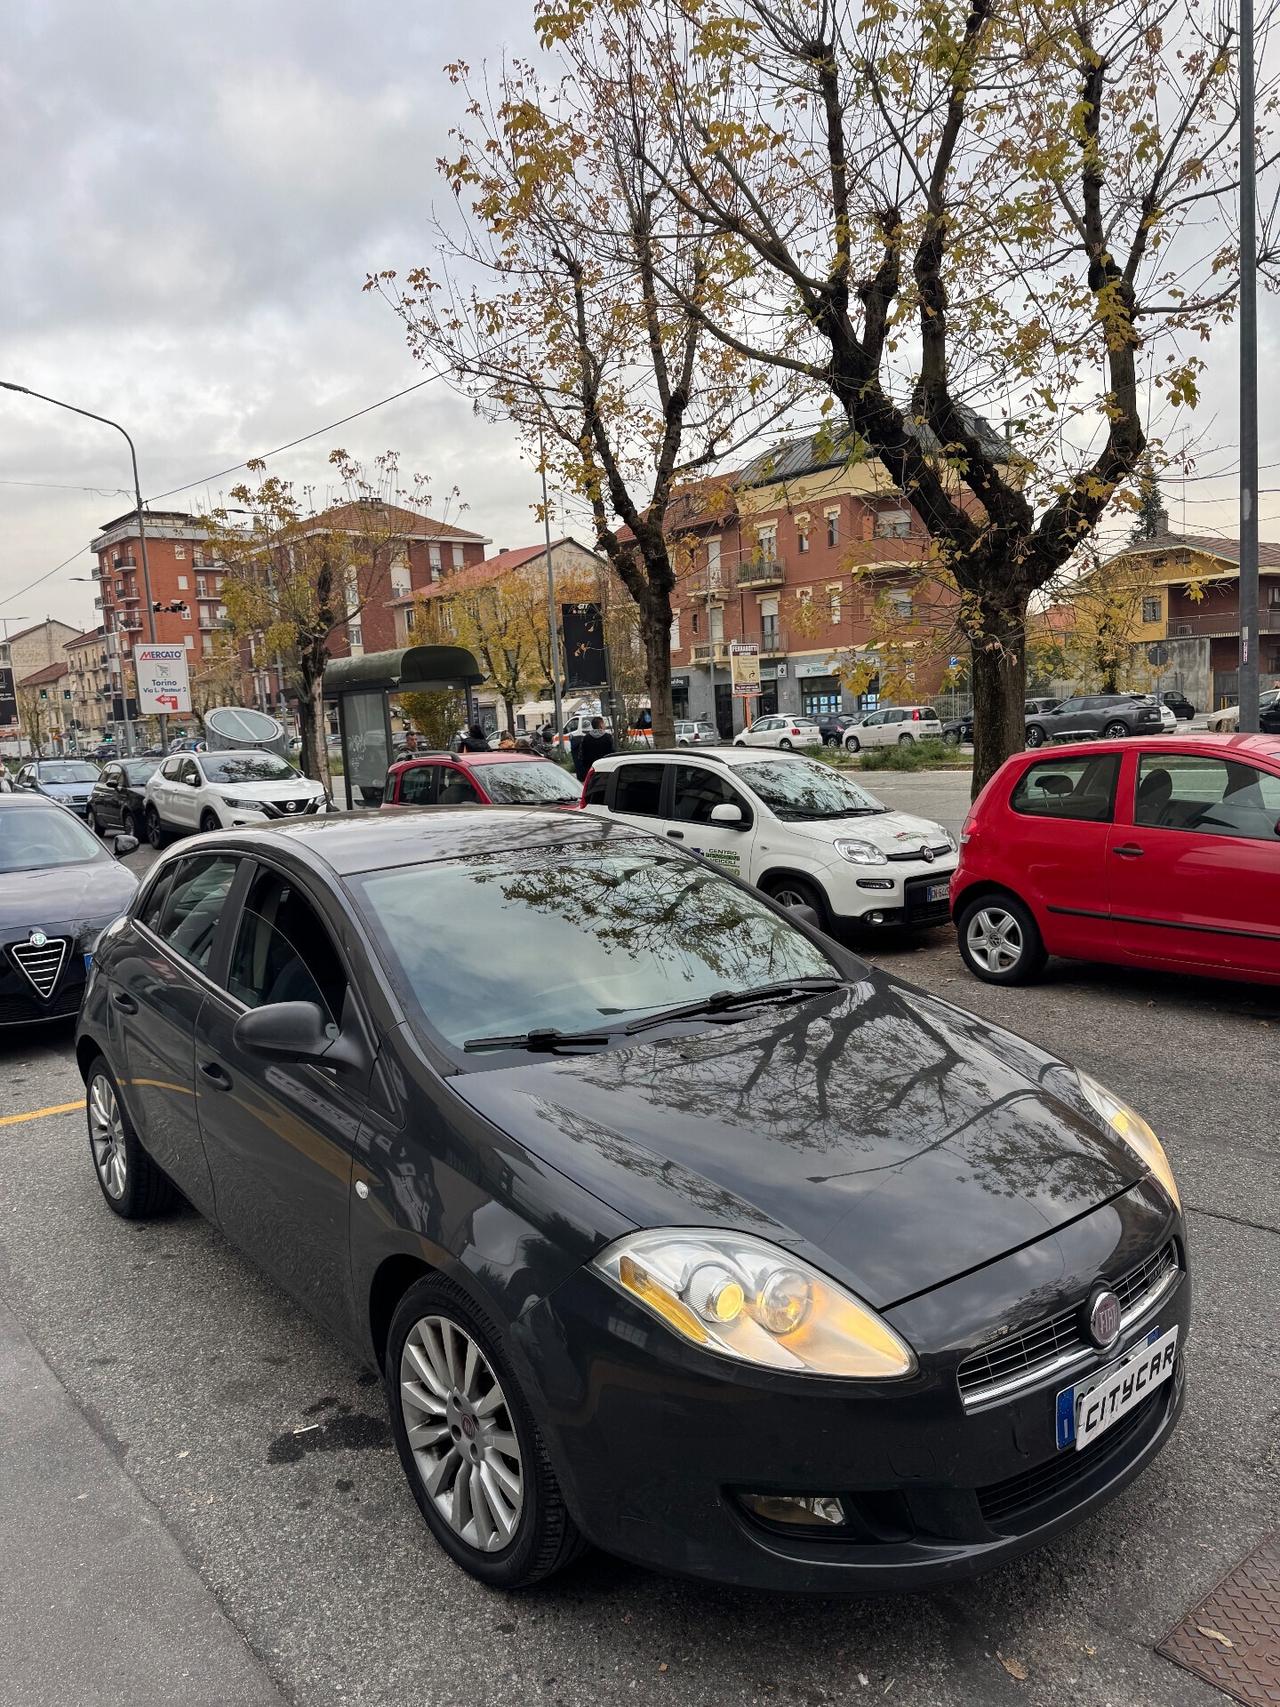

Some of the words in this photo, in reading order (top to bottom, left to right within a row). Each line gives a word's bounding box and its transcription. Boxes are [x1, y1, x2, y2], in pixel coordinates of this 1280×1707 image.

[140, 651, 181, 660] MERCATO
[1099, 1304, 1118, 1335] FIAT
[1085, 1341, 1175, 1433] CITYCAR
